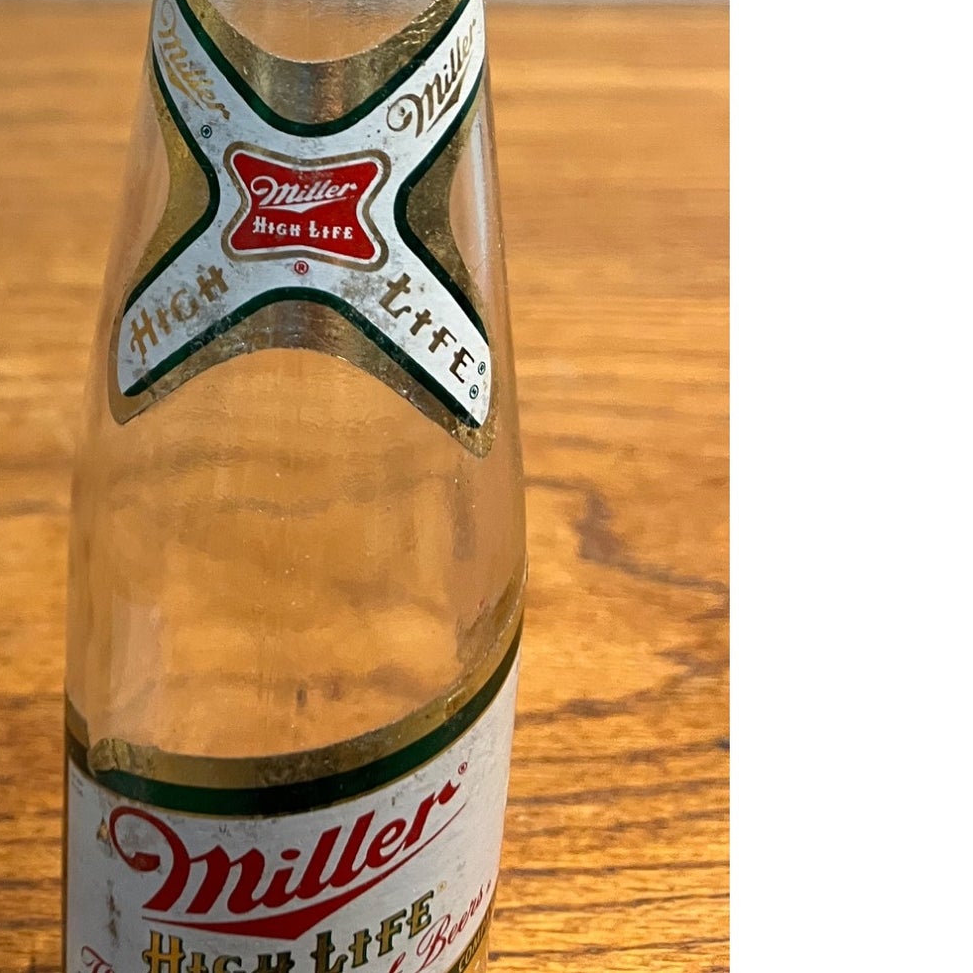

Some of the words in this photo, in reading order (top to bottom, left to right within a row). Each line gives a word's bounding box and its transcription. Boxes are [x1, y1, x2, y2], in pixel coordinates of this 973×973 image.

[157, 0, 230, 119] Miller
[386, 17, 477, 137] Miller
[251, 176, 358, 214] Miller
[109, 780, 466, 940] Miller
